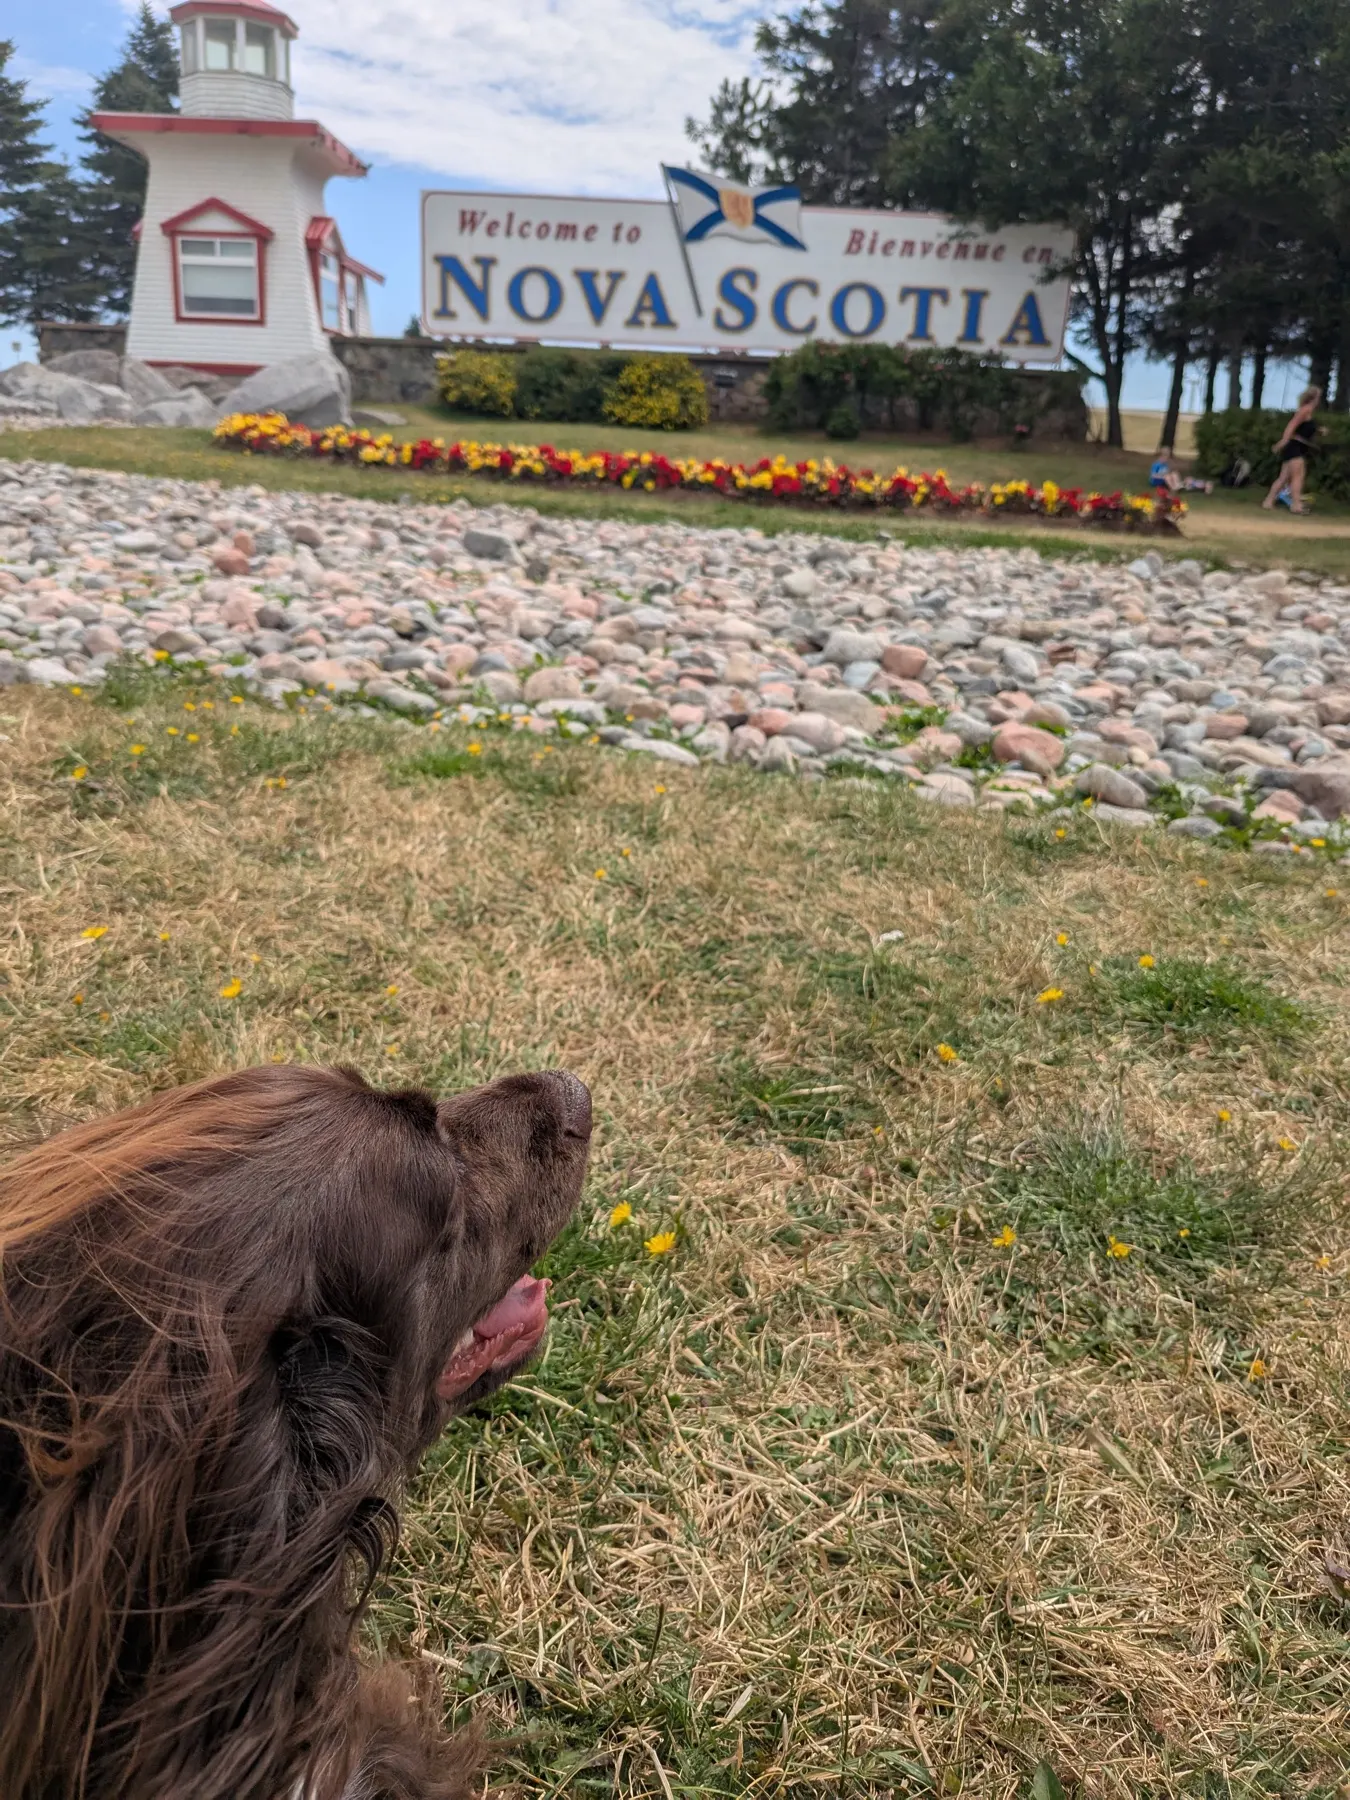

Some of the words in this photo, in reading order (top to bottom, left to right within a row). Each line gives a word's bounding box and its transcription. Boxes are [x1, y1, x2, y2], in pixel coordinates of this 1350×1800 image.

[458, 208, 598, 242] Welcome
[613, 222, 641, 244] to
[844, 228, 1006, 261] Bienvenue
[1022, 244, 1053, 264] en
[433, 254, 678, 330] NOVA
[714, 266, 1052, 347] SCOTIA
